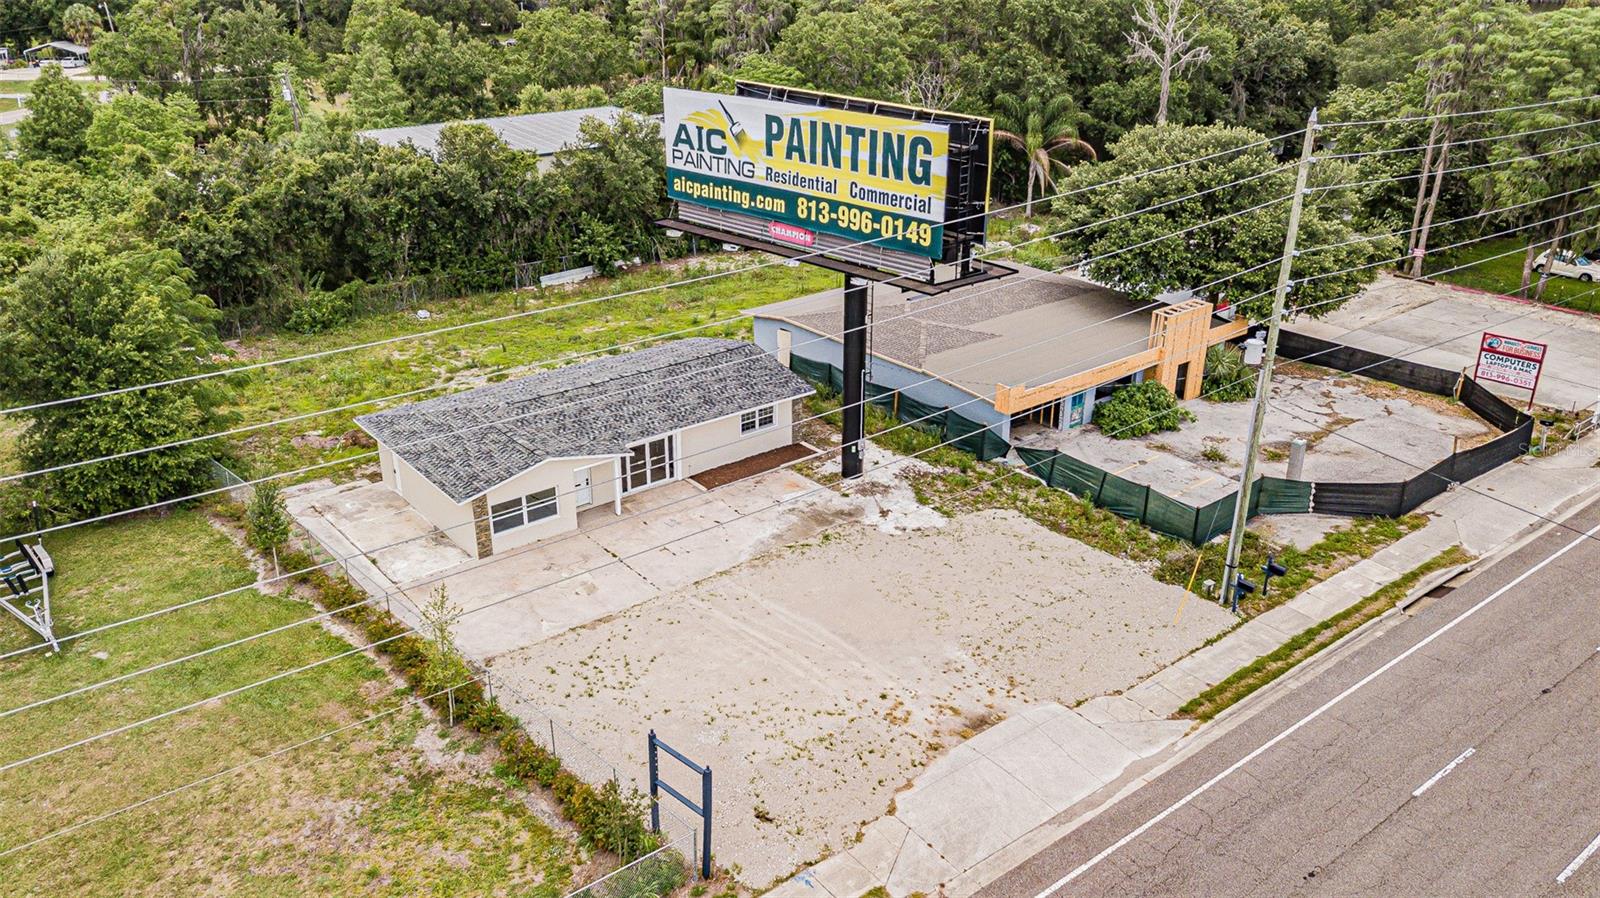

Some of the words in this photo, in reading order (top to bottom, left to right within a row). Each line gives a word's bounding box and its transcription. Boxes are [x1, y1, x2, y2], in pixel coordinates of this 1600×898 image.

[672, 123, 727, 155] AIC
[765, 113, 933, 187] PAINTING
[672, 148, 756, 179] PAINTING
[766, 166, 837, 194] Residential
[850, 181, 932, 214] Commercial
[673, 176, 786, 214] aicpainting.com
[797, 197, 932, 247] 813-996-0149
[770, 225, 812, 243] CHAMPION
[1484, 353, 1537, 370] COMPUTERS
[1486, 361, 1512, 370] LAPTOPS
[1519, 367, 1533, 375] MAC
[1513, 347, 1541, 358] BUSINESS
